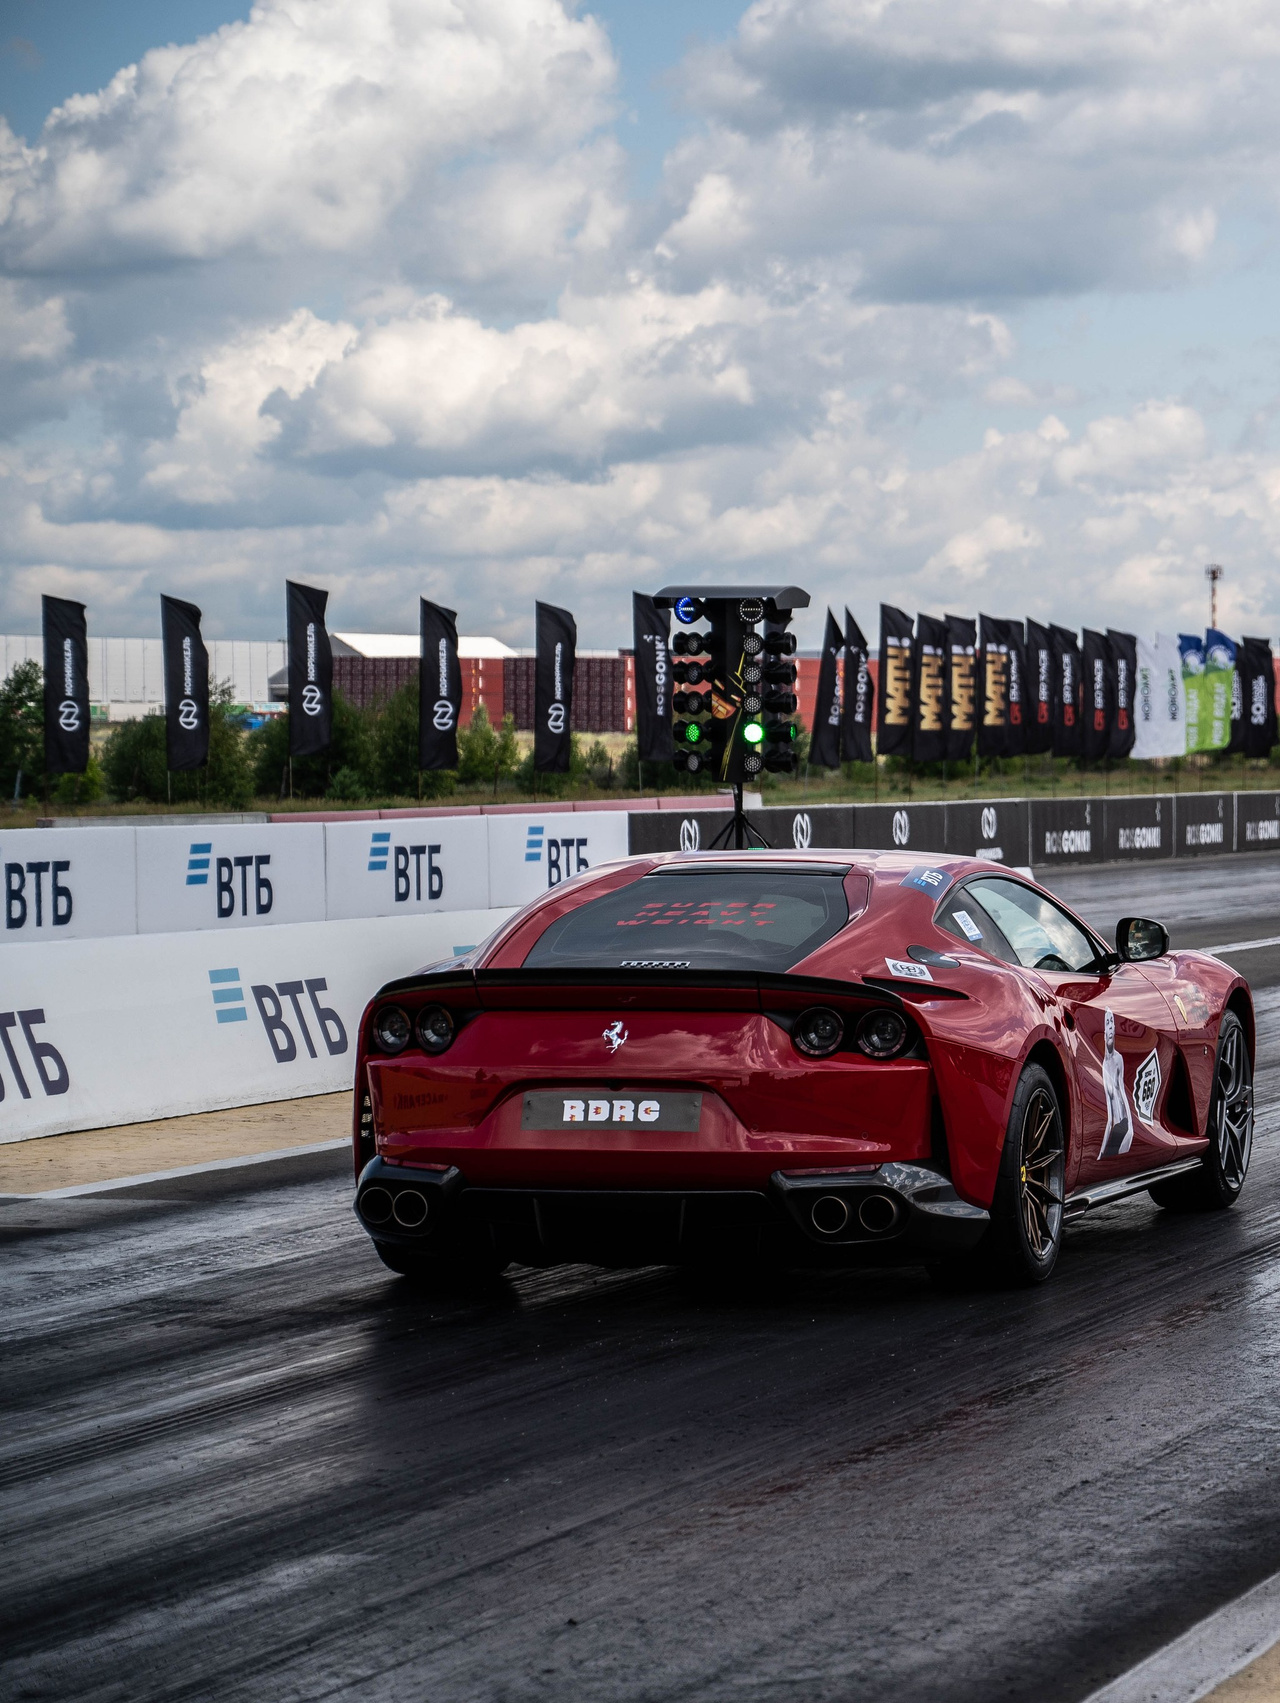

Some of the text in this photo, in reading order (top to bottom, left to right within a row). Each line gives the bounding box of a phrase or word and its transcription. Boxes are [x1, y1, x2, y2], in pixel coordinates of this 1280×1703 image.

[4, 860, 73, 930] ВТБ
[216, 854, 274, 918] ВТБ
[394, 844, 444, 902] ВТБ
[251, 977, 349, 1064] ВТБ
[0, 1009, 70, 1100] ТБ
[563, 1100, 660, 1122] RDRC
